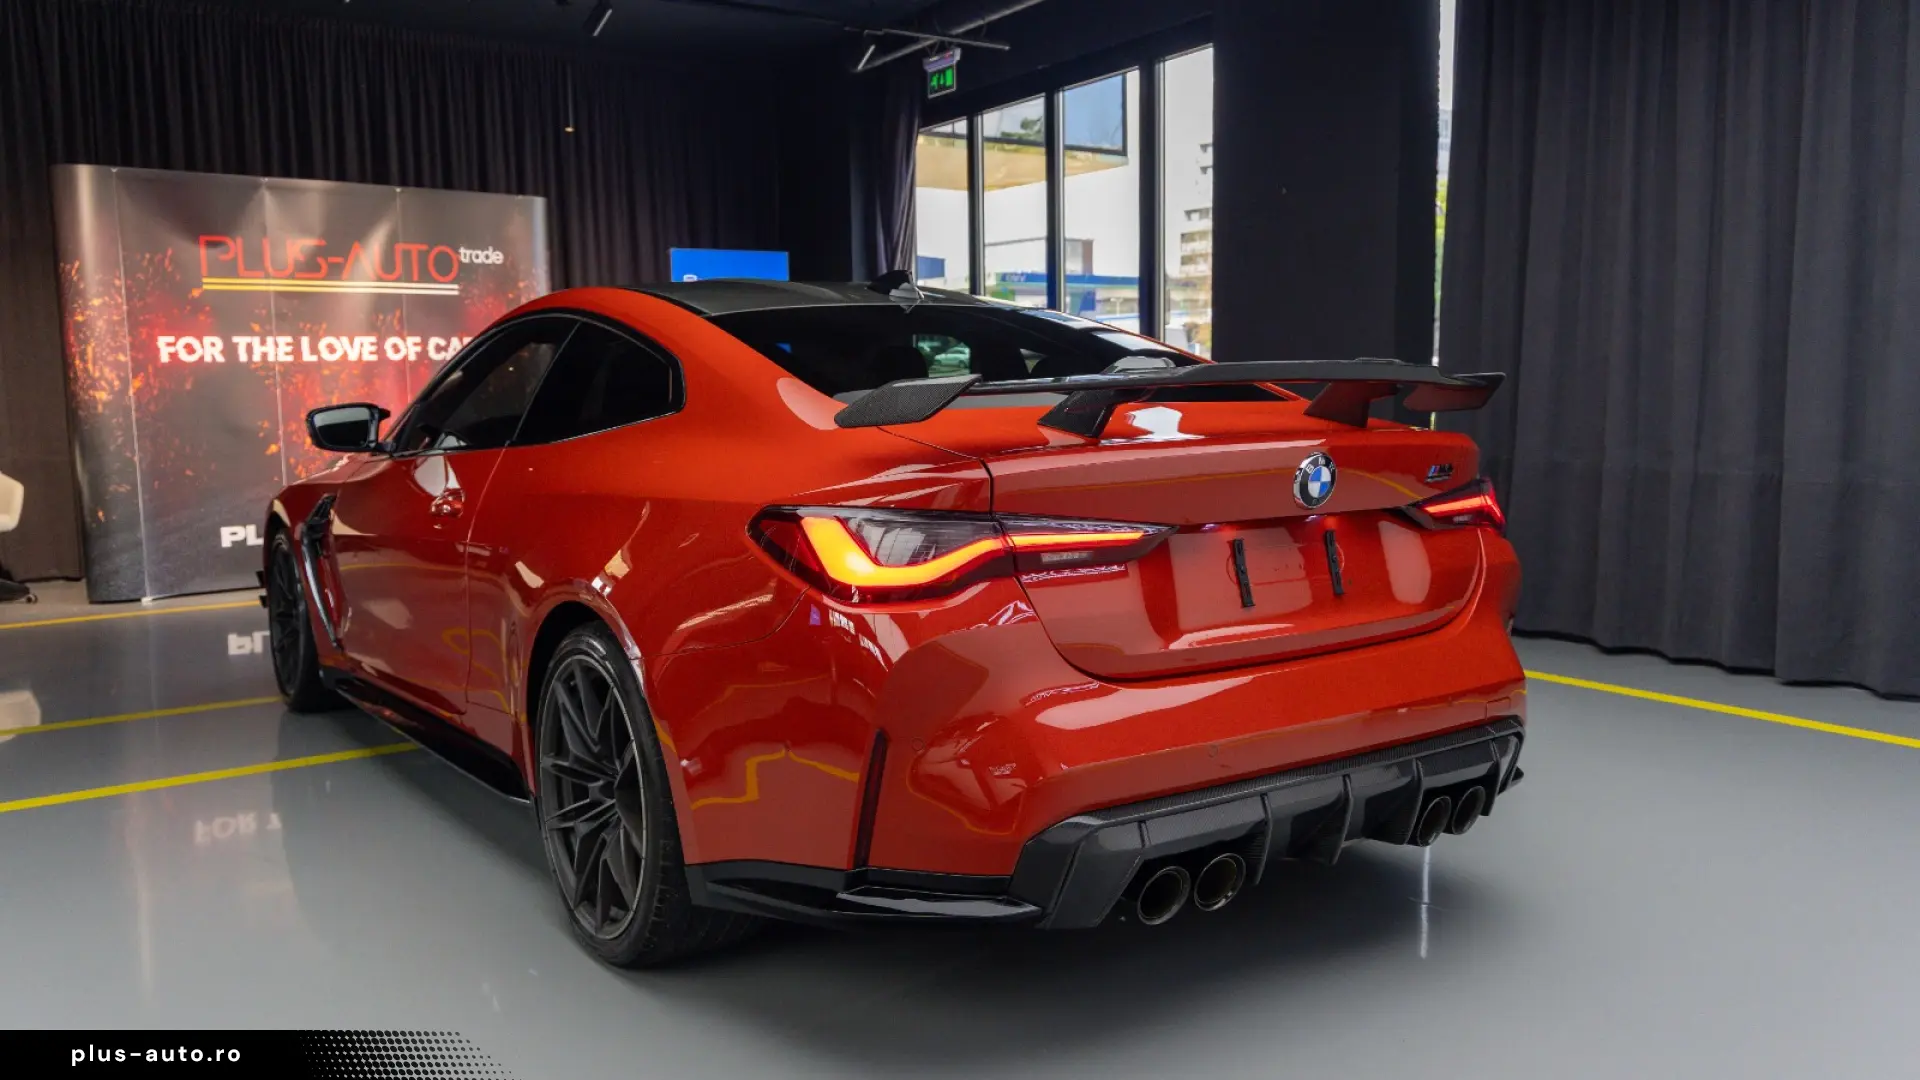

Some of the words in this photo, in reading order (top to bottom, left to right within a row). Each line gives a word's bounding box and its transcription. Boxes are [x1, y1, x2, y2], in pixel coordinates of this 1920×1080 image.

[199, 235, 460, 283] PLUS-AUTO
[459, 246, 504, 266] trade
[156, 335, 226, 364] FOR
[232, 336, 295, 363] THE
[301, 336, 379, 363] LOVE
[384, 336, 422, 362] OF
